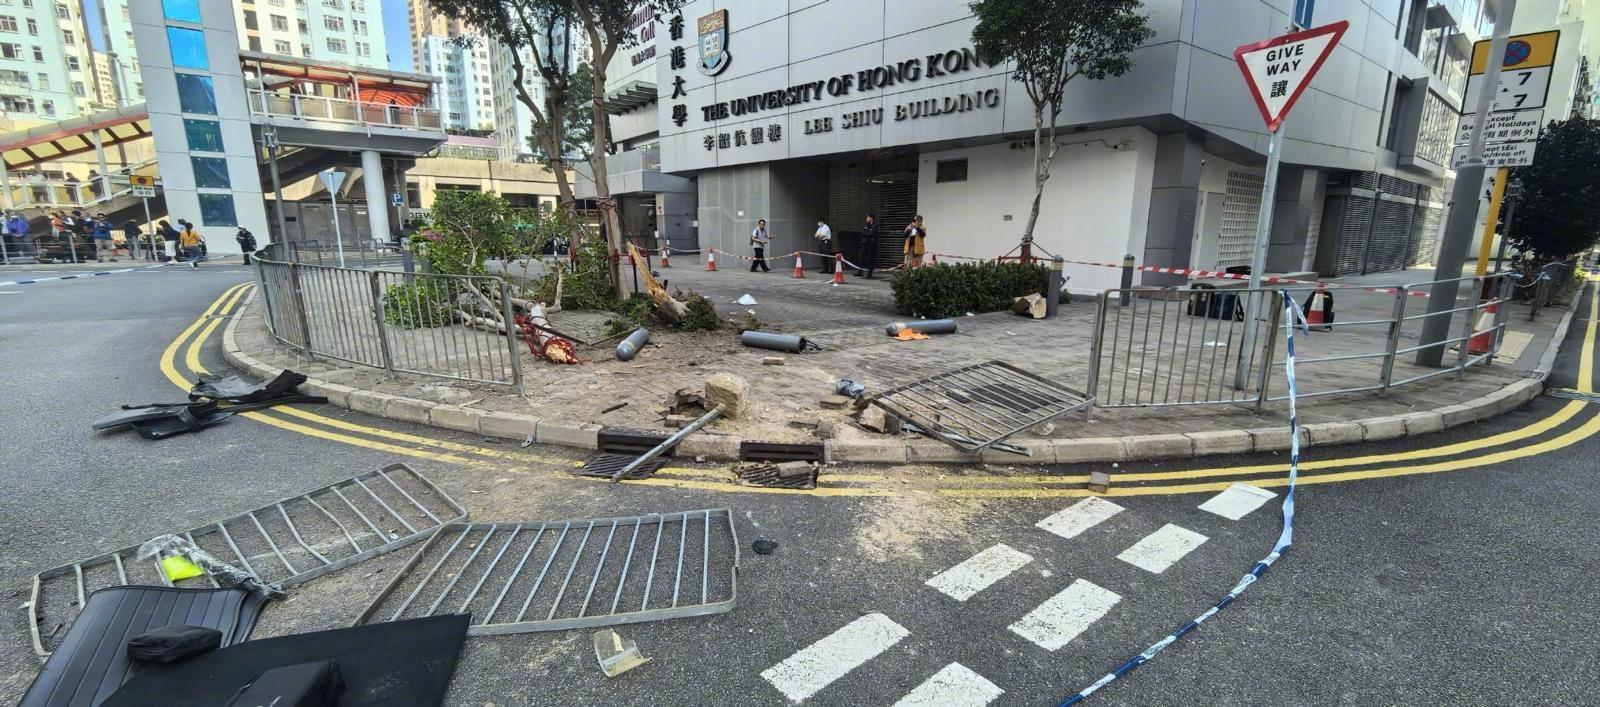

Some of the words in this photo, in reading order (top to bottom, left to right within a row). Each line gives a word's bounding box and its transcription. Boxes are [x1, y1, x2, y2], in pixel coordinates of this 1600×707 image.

[1266, 43, 1304, 61] GIVE
[668, 15, 688, 127] 香港大學
[1266, 59, 1302, 76] WAY
[701, 102, 729, 122] THE
[730, 80, 825, 117] UNIVERSITY
[827, 73, 855, 98] OF
[857, 58, 920, 92] HONG
[925, 47, 981, 79] KON
[1270, 80, 1289, 98] 讓
[804, 117, 833, 136] LEE
[842, 108, 883, 130] SHIU
[893, 88, 1000, 122] BUILDING
[1498, 119, 1537, 129] Holidays
